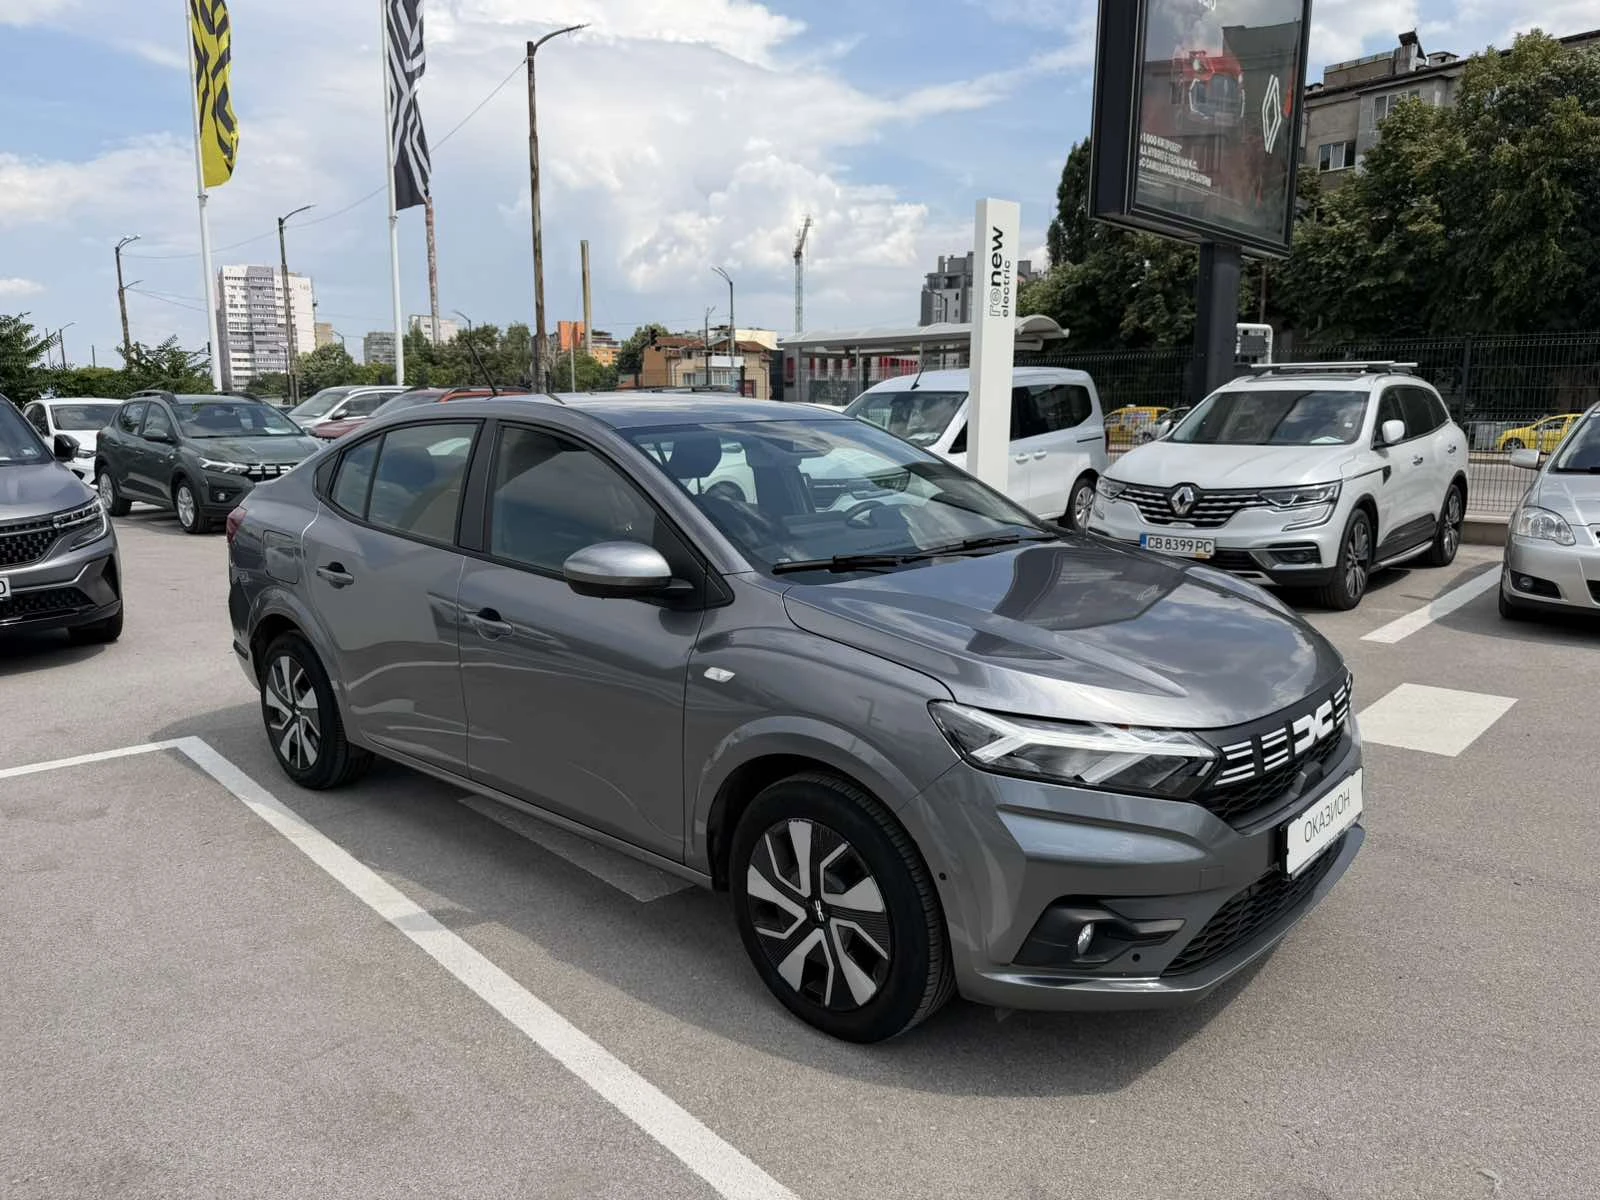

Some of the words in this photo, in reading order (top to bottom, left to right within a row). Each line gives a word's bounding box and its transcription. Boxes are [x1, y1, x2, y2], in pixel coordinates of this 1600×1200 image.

[1001, 260, 1011, 318] electric
[1164, 539, 1194, 552] 8399
[1304, 787, 1350, 843] ОКАЗИОН
